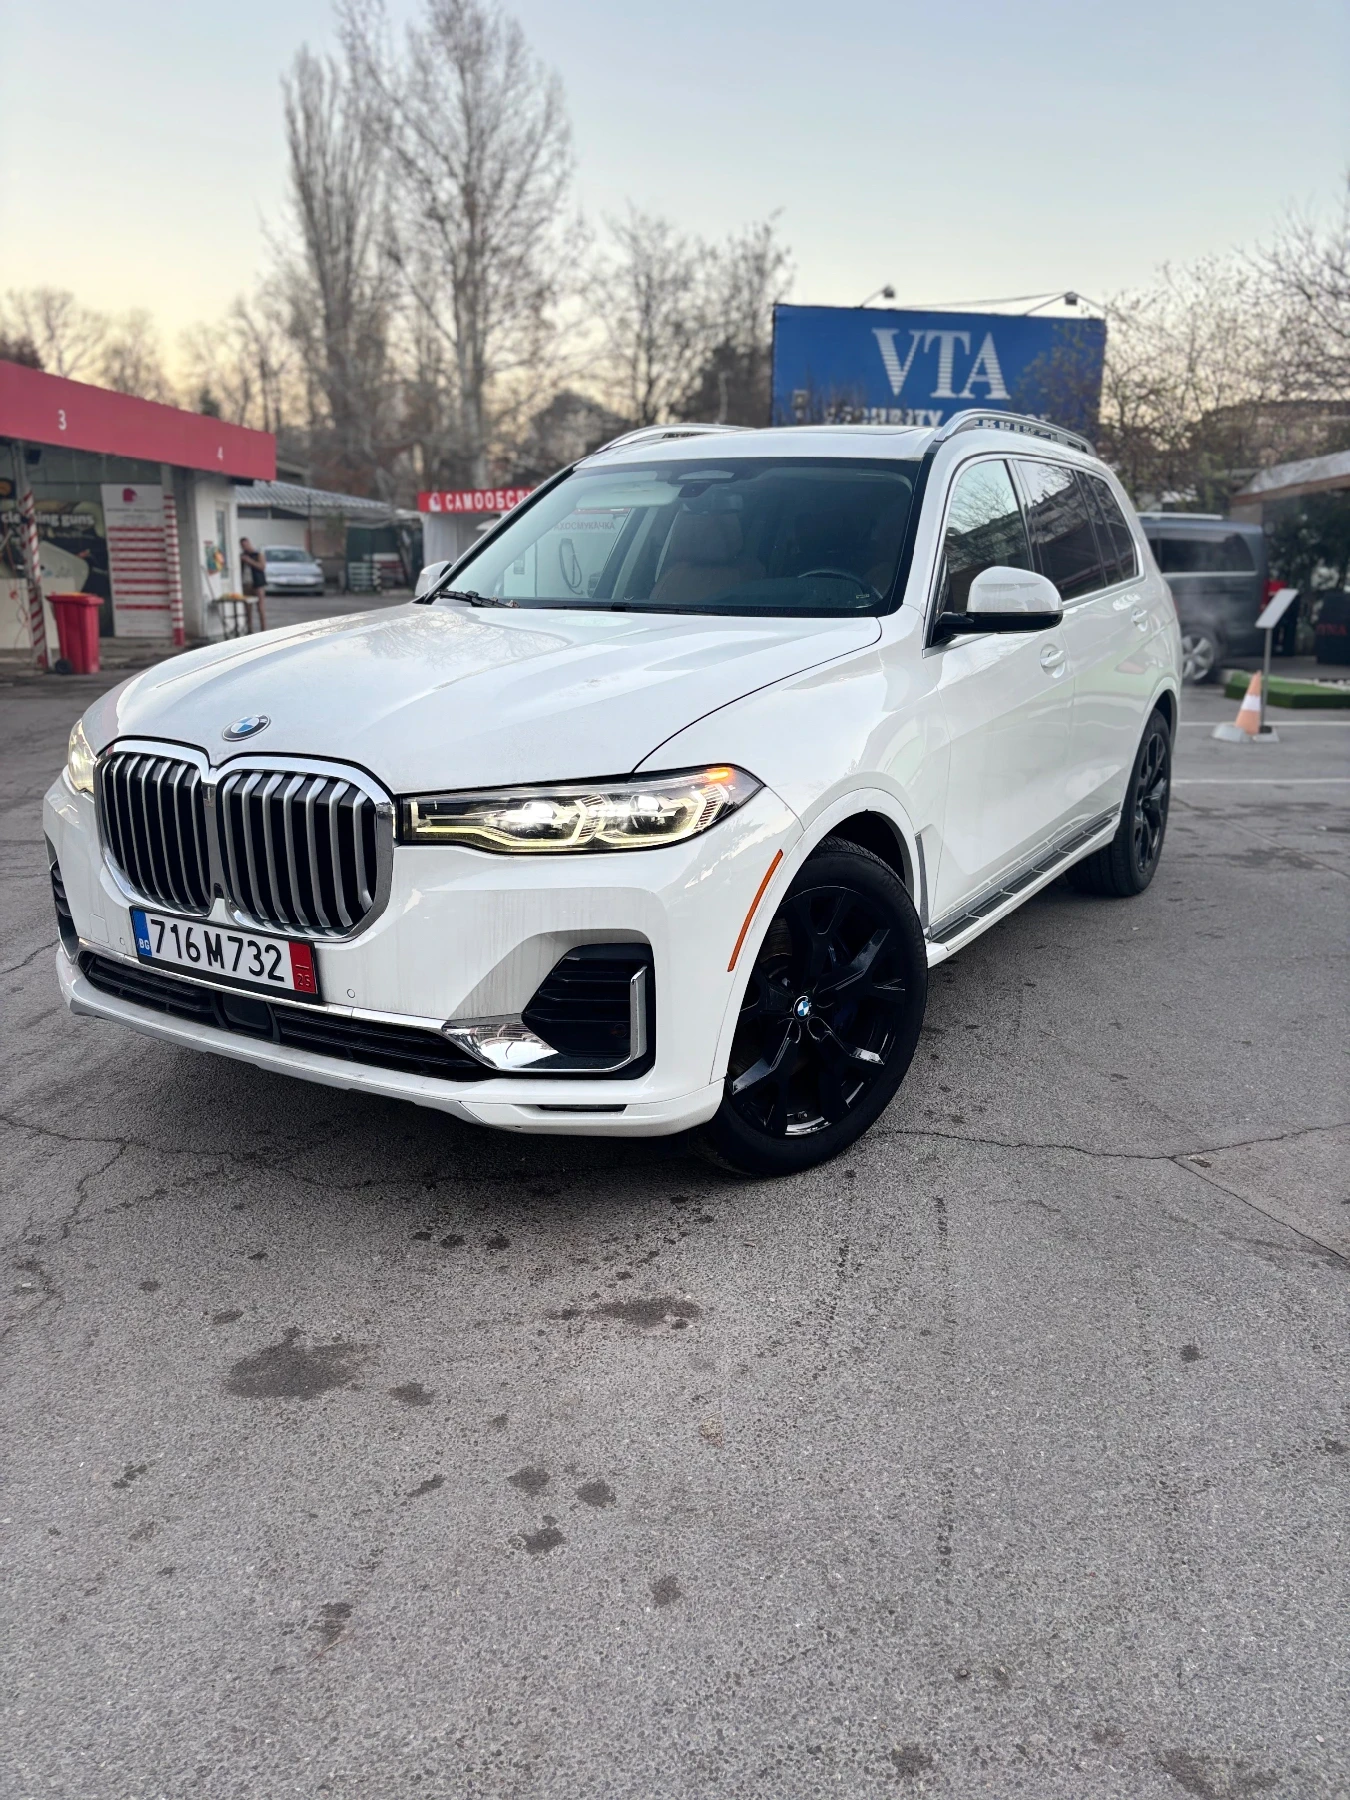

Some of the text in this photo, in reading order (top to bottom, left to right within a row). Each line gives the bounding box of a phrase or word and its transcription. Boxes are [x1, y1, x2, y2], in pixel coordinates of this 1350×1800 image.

[872, 327, 1011, 400] VTA
[57, 409, 67, 431] 3
[217, 446, 224, 461] 4
[445, 489, 531, 511] САМООБСЛ
[1, 510, 95, 527] cleing guns
[553, 521, 616, 531] АХОСМУКАЧКА
[138, 937, 150, 951] BG
[151, 918, 285, 982] 716M732
